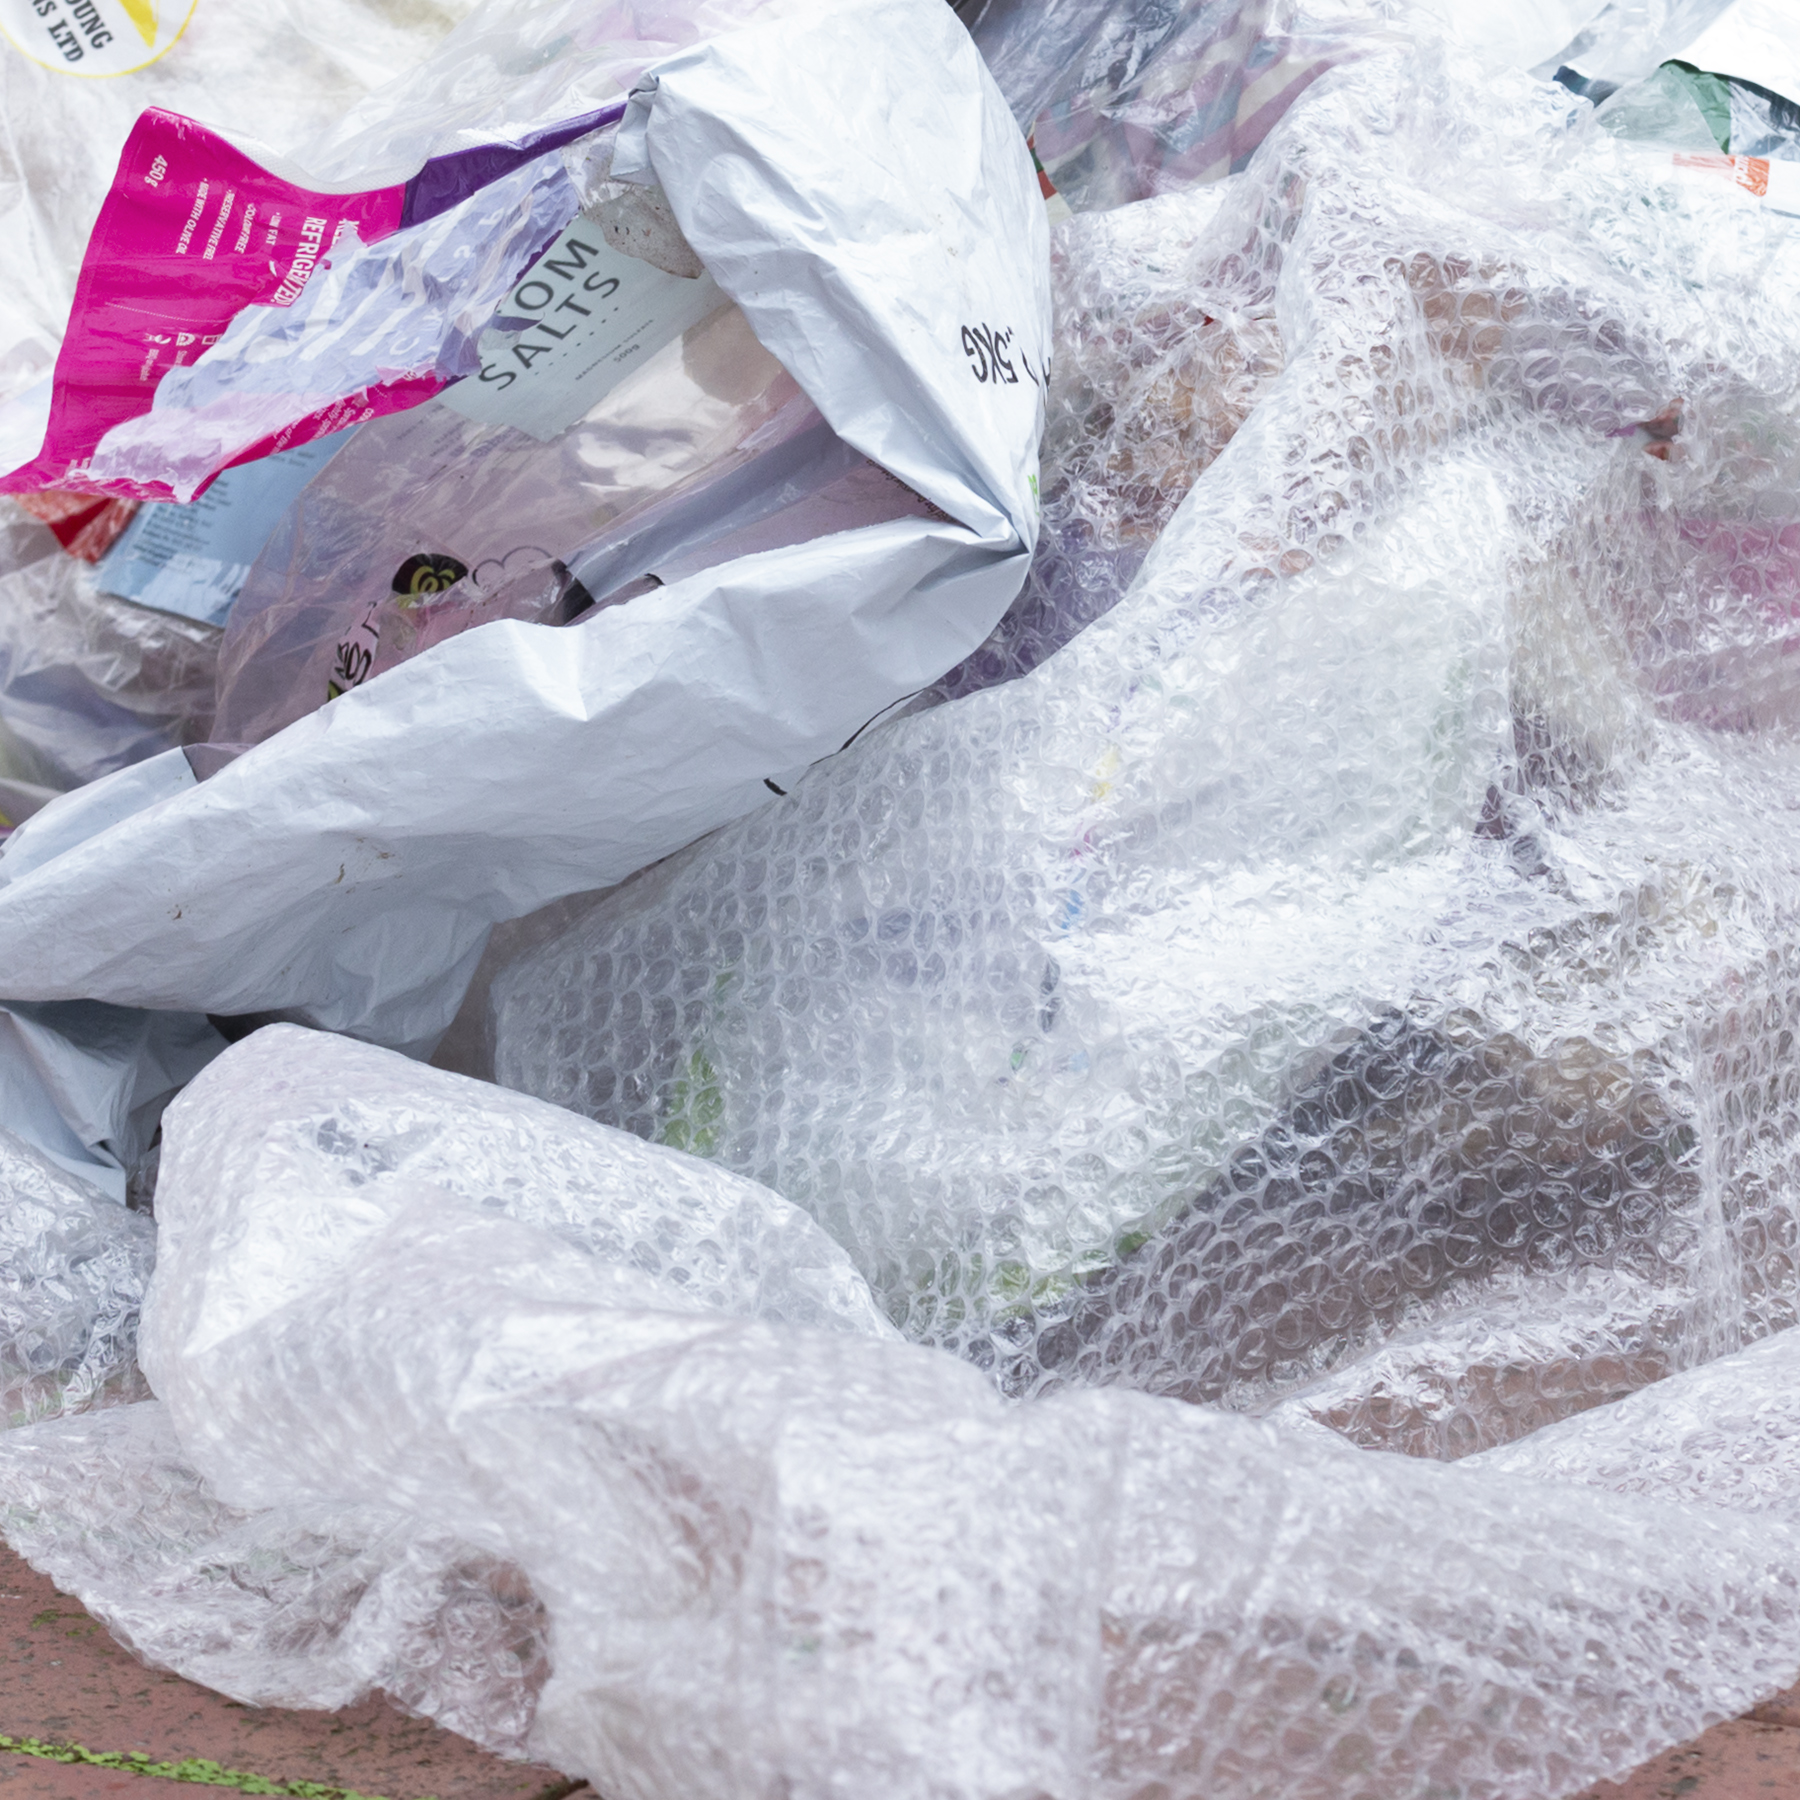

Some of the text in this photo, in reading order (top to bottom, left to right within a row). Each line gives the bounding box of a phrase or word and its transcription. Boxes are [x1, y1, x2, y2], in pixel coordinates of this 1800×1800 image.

[53, 18, 88, 63] LTD
[143, 153, 168, 188] 450g
[190, 197, 204, 220] WITH
[180, 218, 197, 244] OLIVE
[233, 232, 249, 254] FREE
[265, 228, 277, 245] FAT
[515, 237, 600, 312] OM
[479, 277, 621, 392] SALTS
[612, 341, 641, 366] 500g
